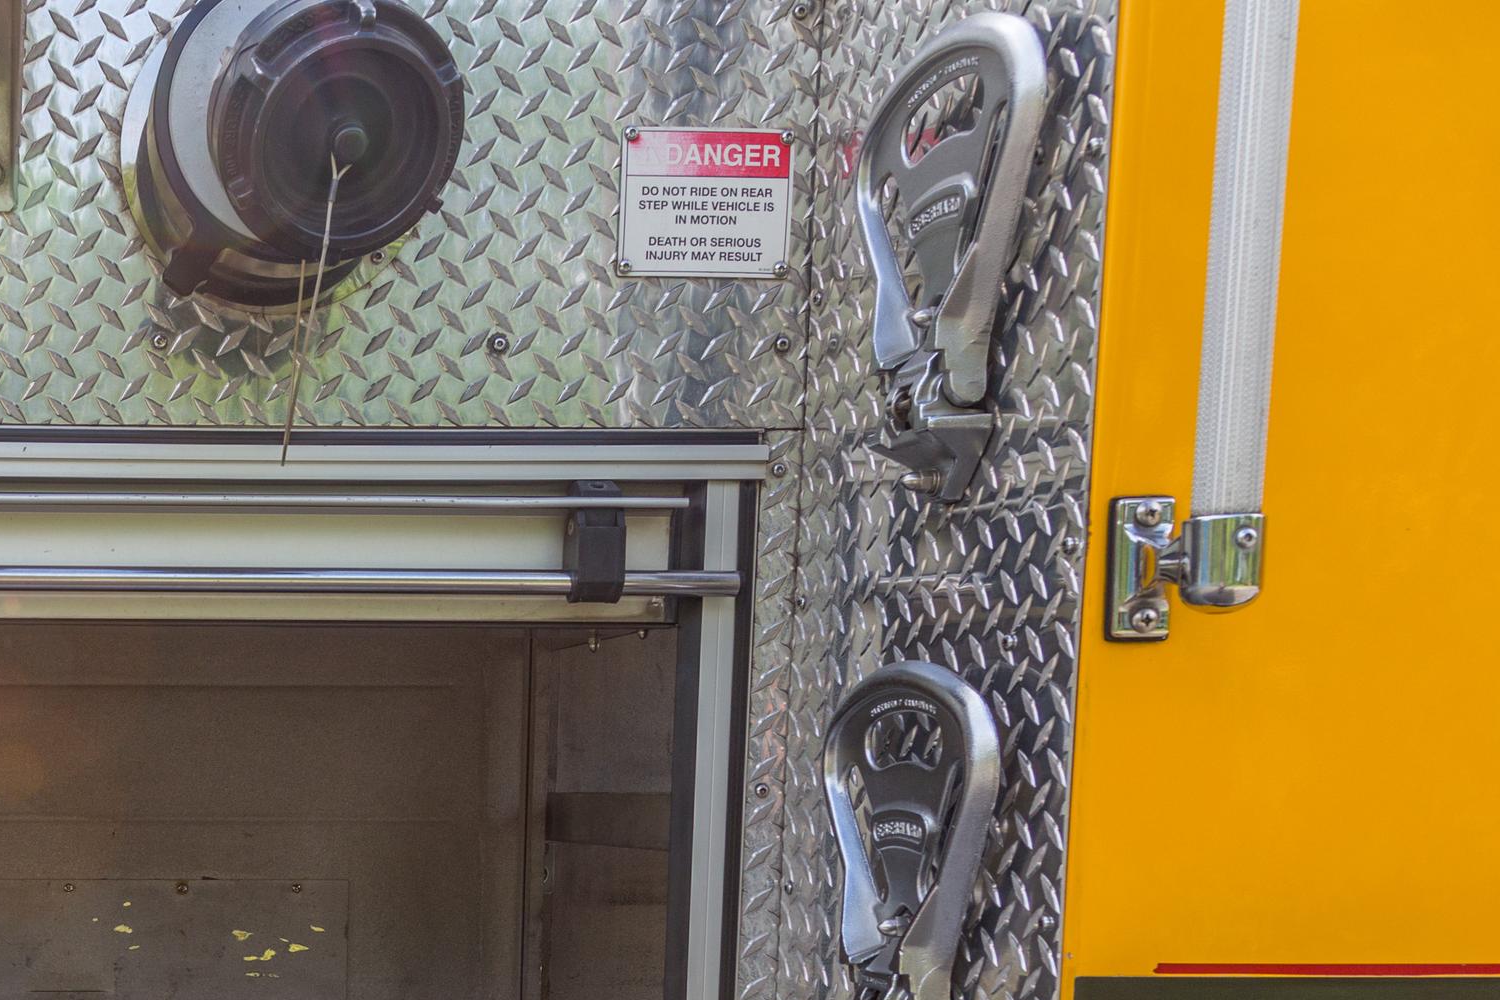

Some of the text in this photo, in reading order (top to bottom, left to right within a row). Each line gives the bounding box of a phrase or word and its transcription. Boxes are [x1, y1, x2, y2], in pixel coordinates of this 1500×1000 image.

[666, 143, 781, 167] DANGER
[641, 186, 773, 198] DO NOT RIDE ON REAR
[638, 200, 775, 212] STEP WHILE VEHICLE IS
[675, 215, 737, 225] IN MOTION
[648, 236, 761, 248] DEATH OR SERIOUS
[645, 251, 763, 262] INJURY MAY RESULT
